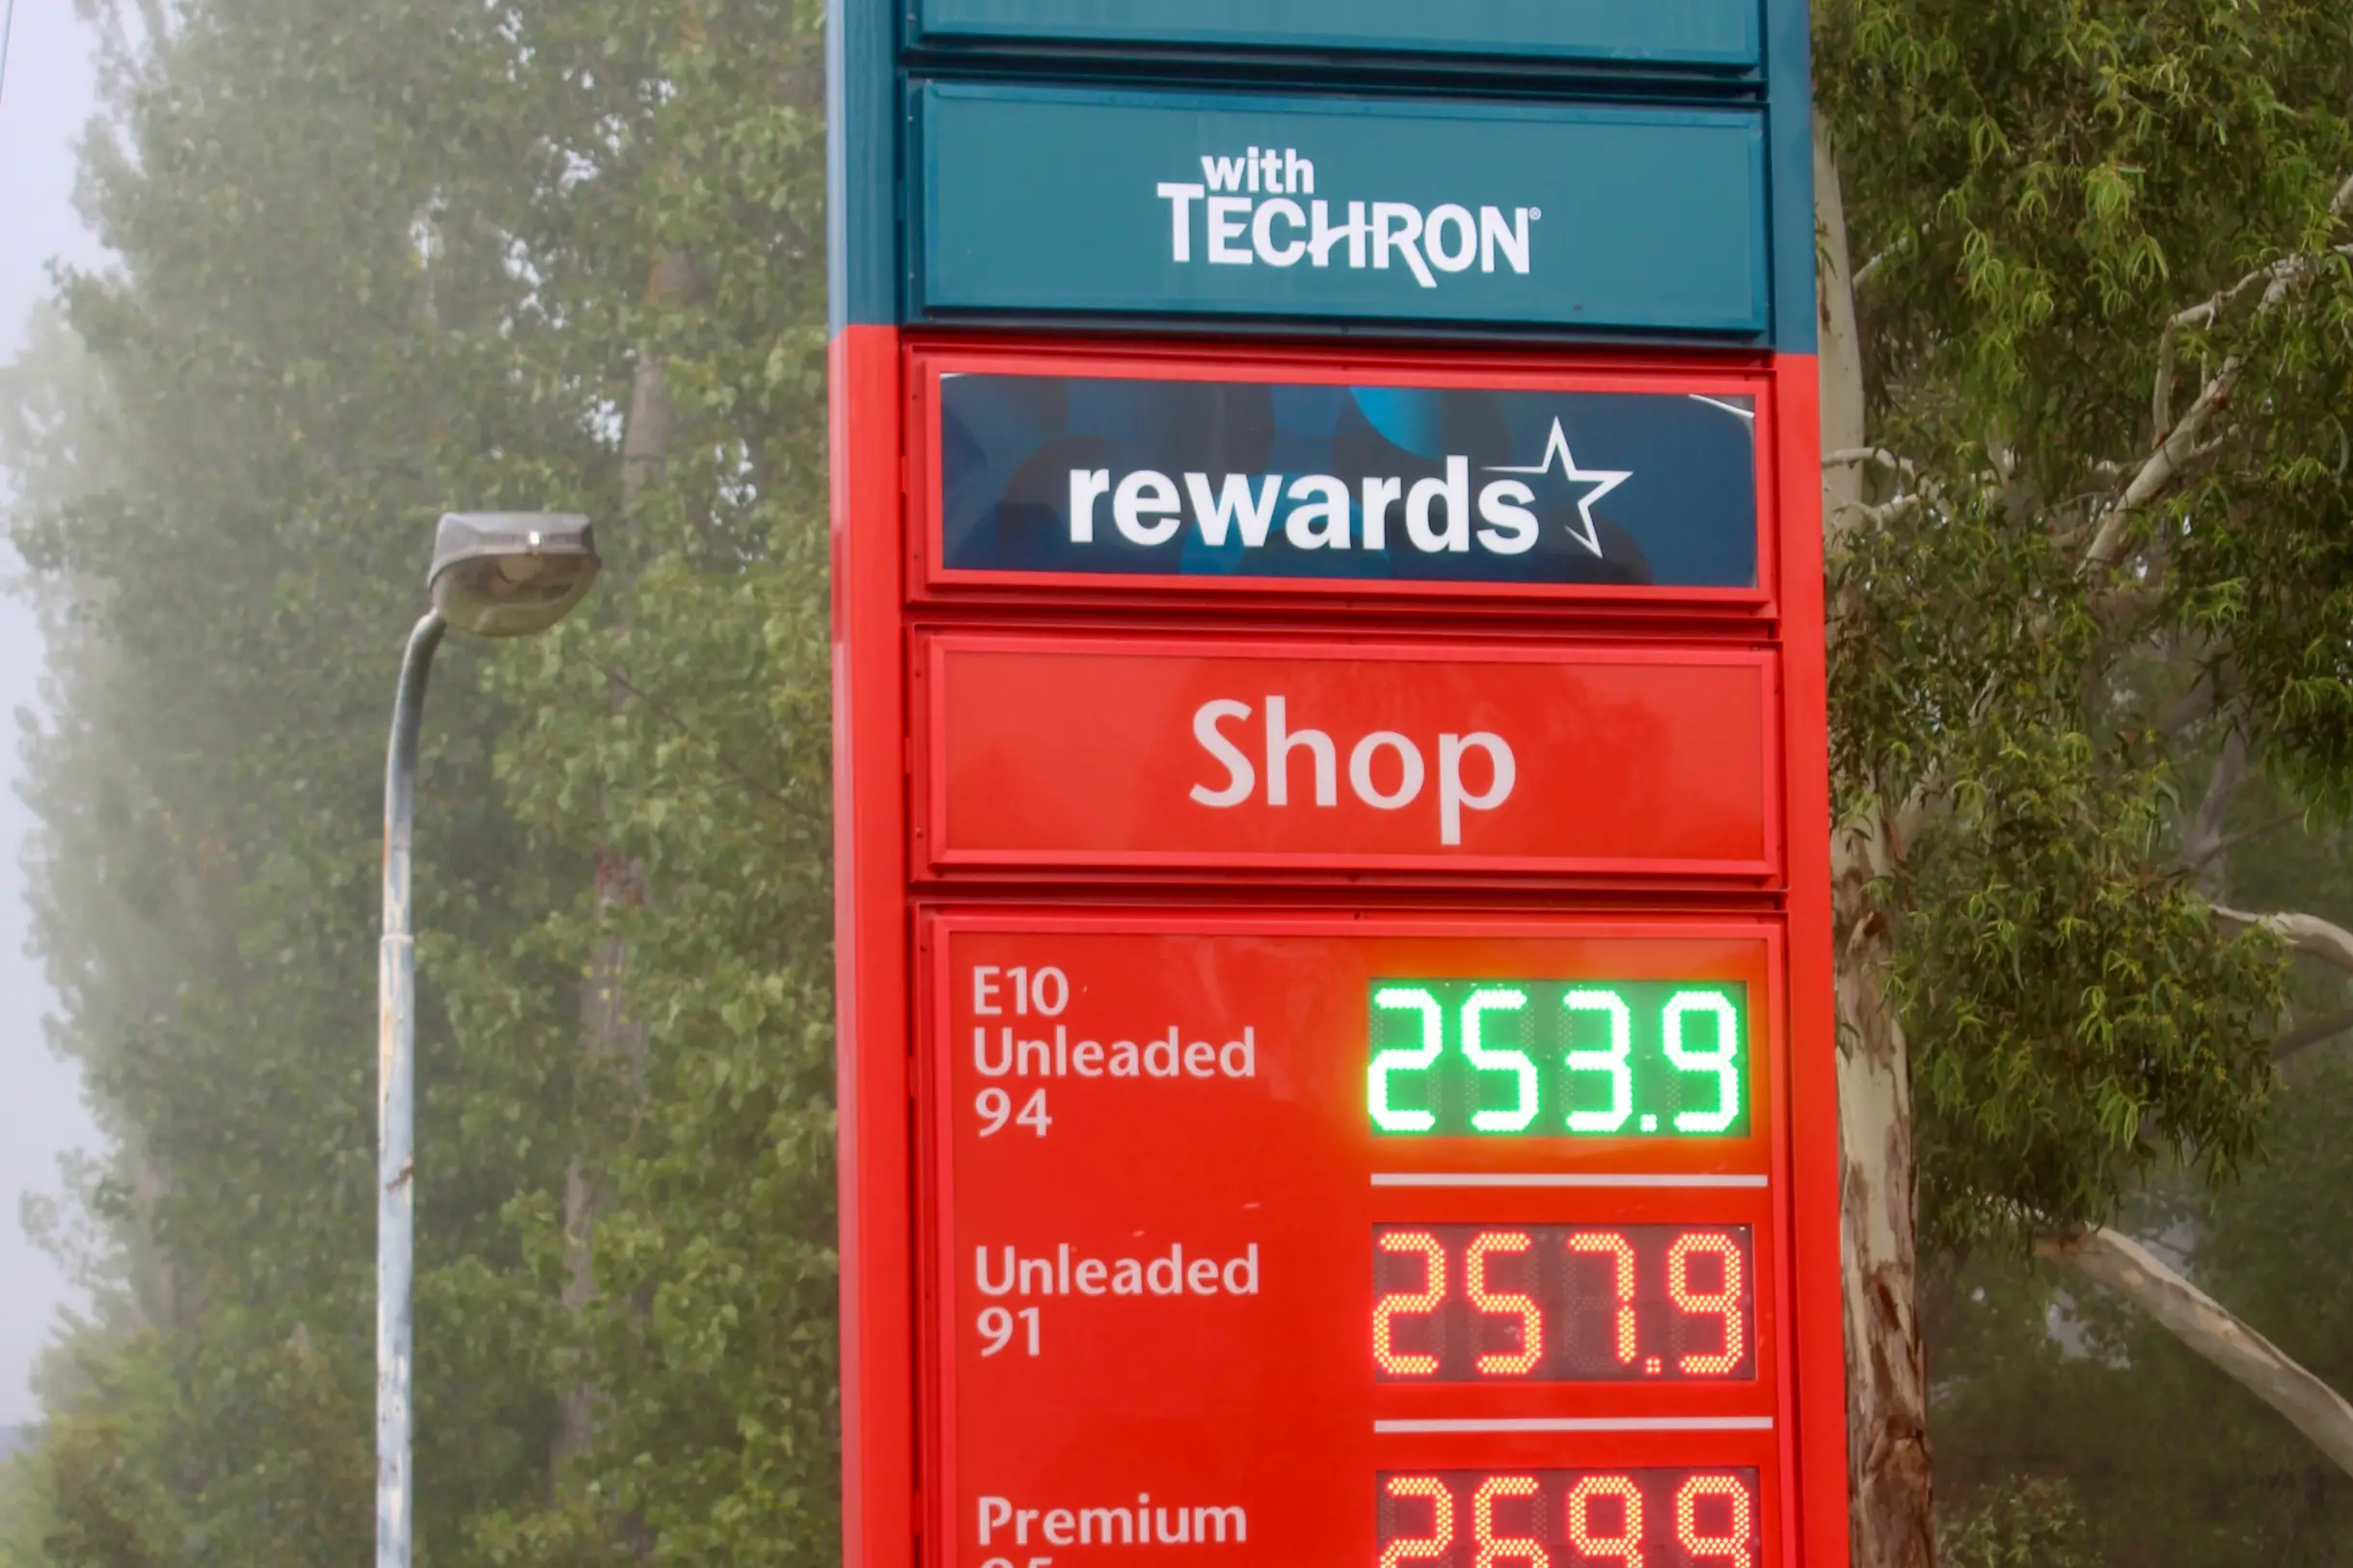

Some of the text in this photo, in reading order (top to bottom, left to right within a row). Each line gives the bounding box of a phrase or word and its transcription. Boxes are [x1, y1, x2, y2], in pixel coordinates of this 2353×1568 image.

[1201, 146, 1314, 194] with
[1068, 455, 1540, 555] rewards
[1188, 694, 1517, 846] Shop
[972, 965, 1069, 1017] E10
[973, 1025, 1257, 1079] Unleaded
[1367, 987, 1740, 1134] 253.9
[975, 1087, 1053, 1138] 94
[974, 1243, 1259, 1296] Unleaded
[1372, 1231, 1744, 1375] 257.9
[976, 1307, 1041, 1357] 91
[977, 1492, 1248, 1546] Premium
